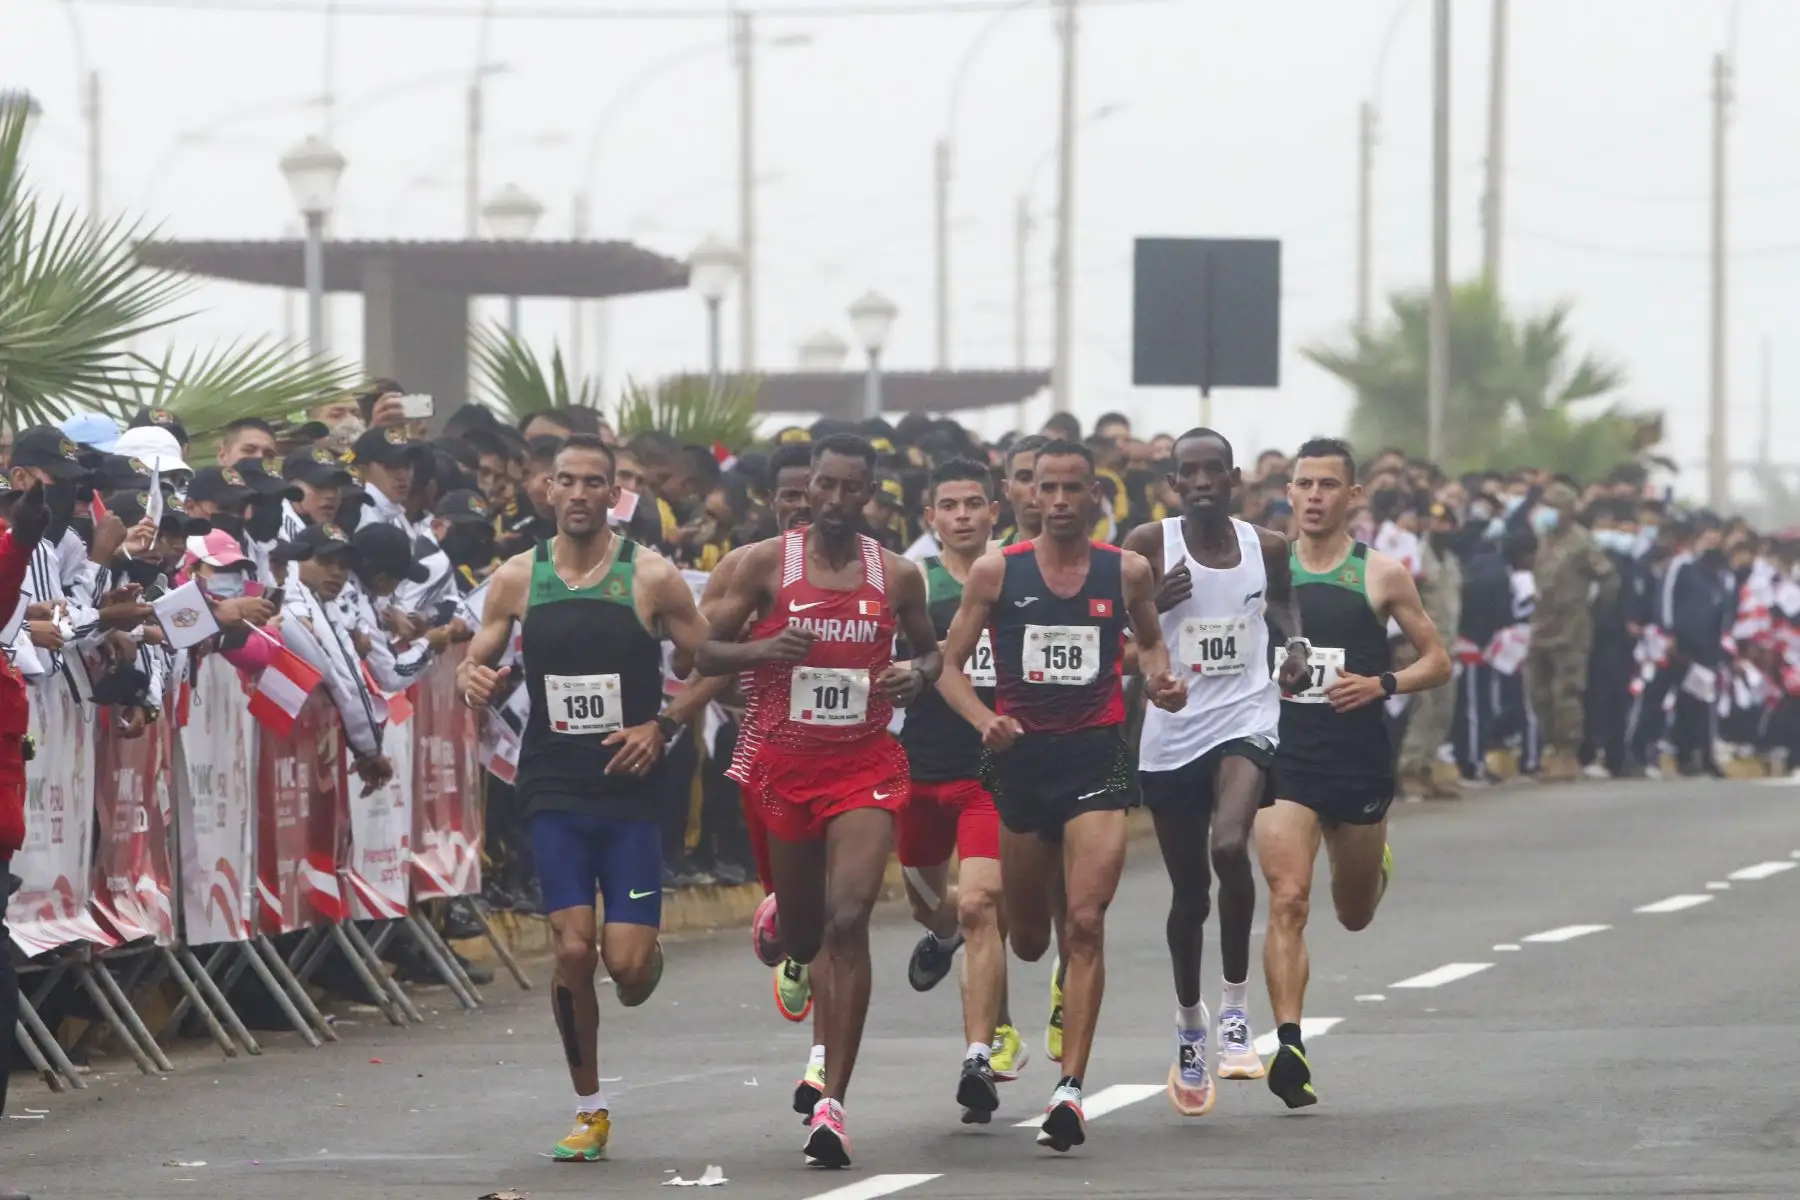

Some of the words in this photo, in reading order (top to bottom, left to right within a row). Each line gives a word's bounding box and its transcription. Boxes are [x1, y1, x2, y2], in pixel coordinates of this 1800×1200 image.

[971, 646, 992, 670] 12
[1041, 645, 1082, 670] 158
[1199, 636, 1237, 661] 104
[562, 694, 605, 719] 130
[812, 686, 850, 710] 101
